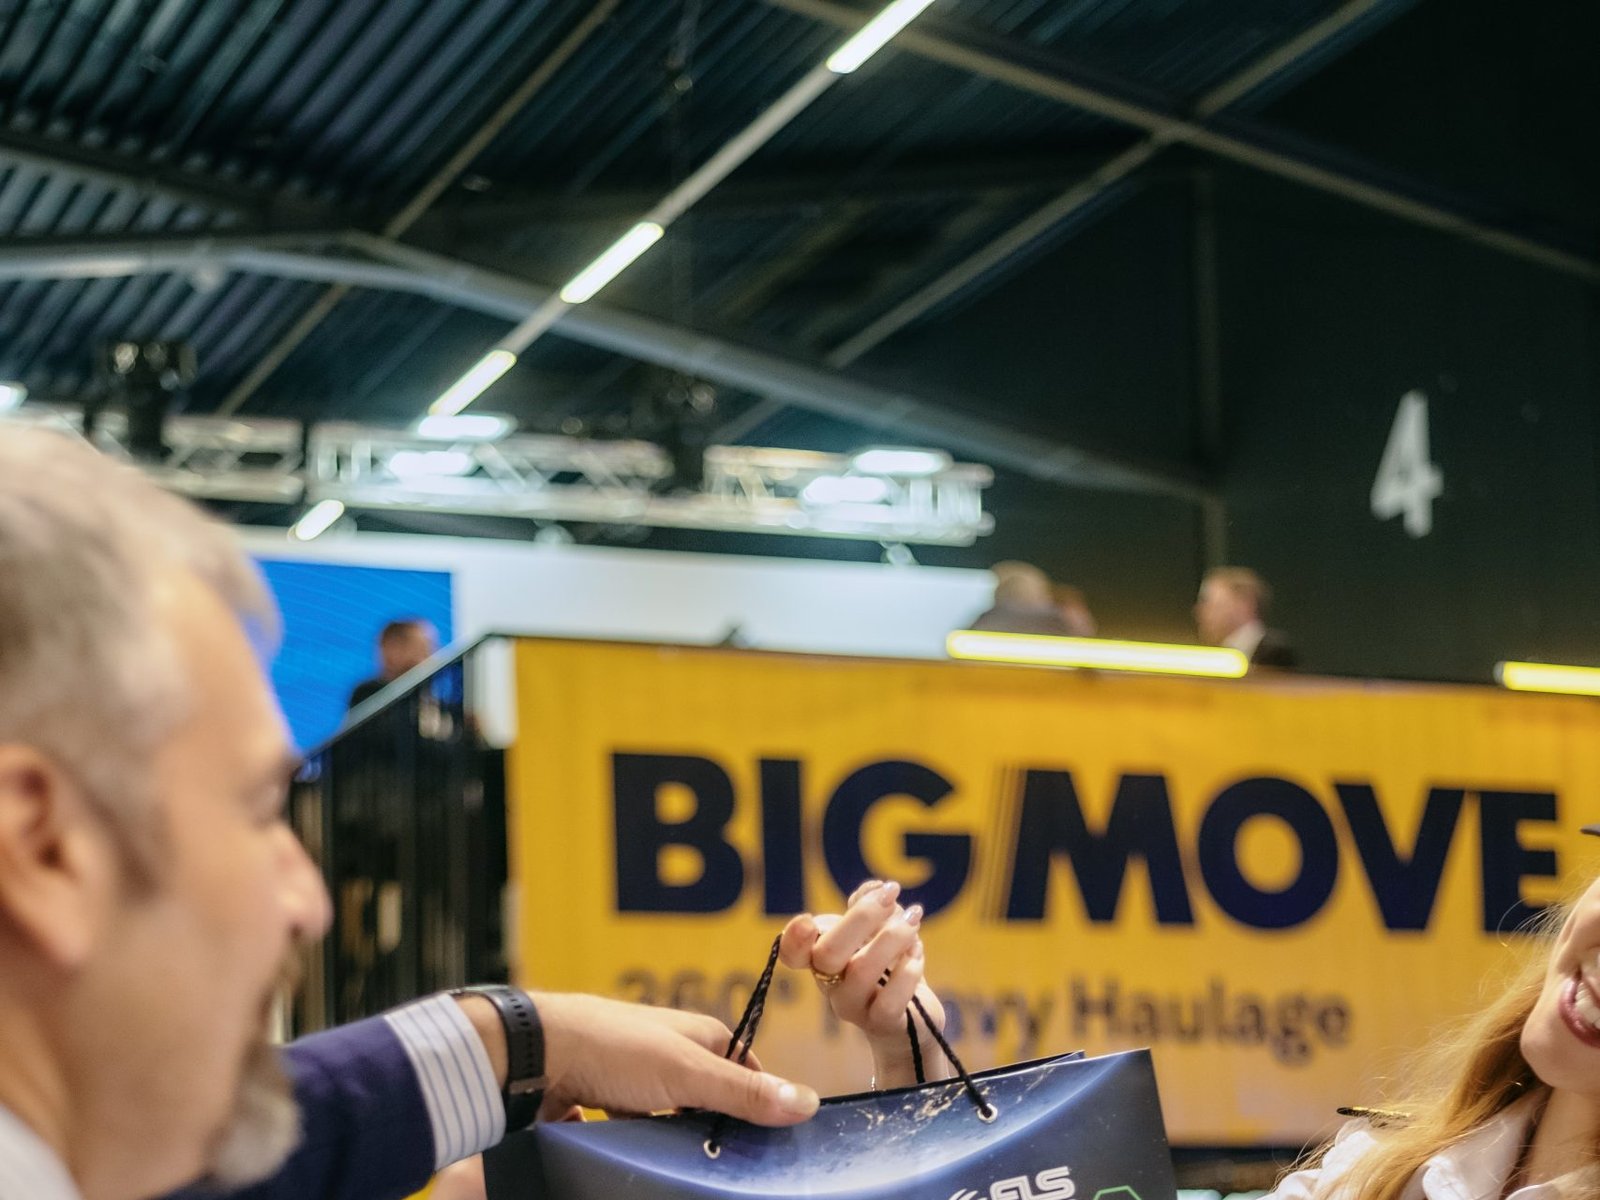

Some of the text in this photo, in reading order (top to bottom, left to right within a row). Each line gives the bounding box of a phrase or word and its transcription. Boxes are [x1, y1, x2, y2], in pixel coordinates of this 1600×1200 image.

[1370, 388, 1444, 538] 4
[611, 752, 1558, 933] BIG MOVE
[1068, 970, 1350, 1066] Haulage
